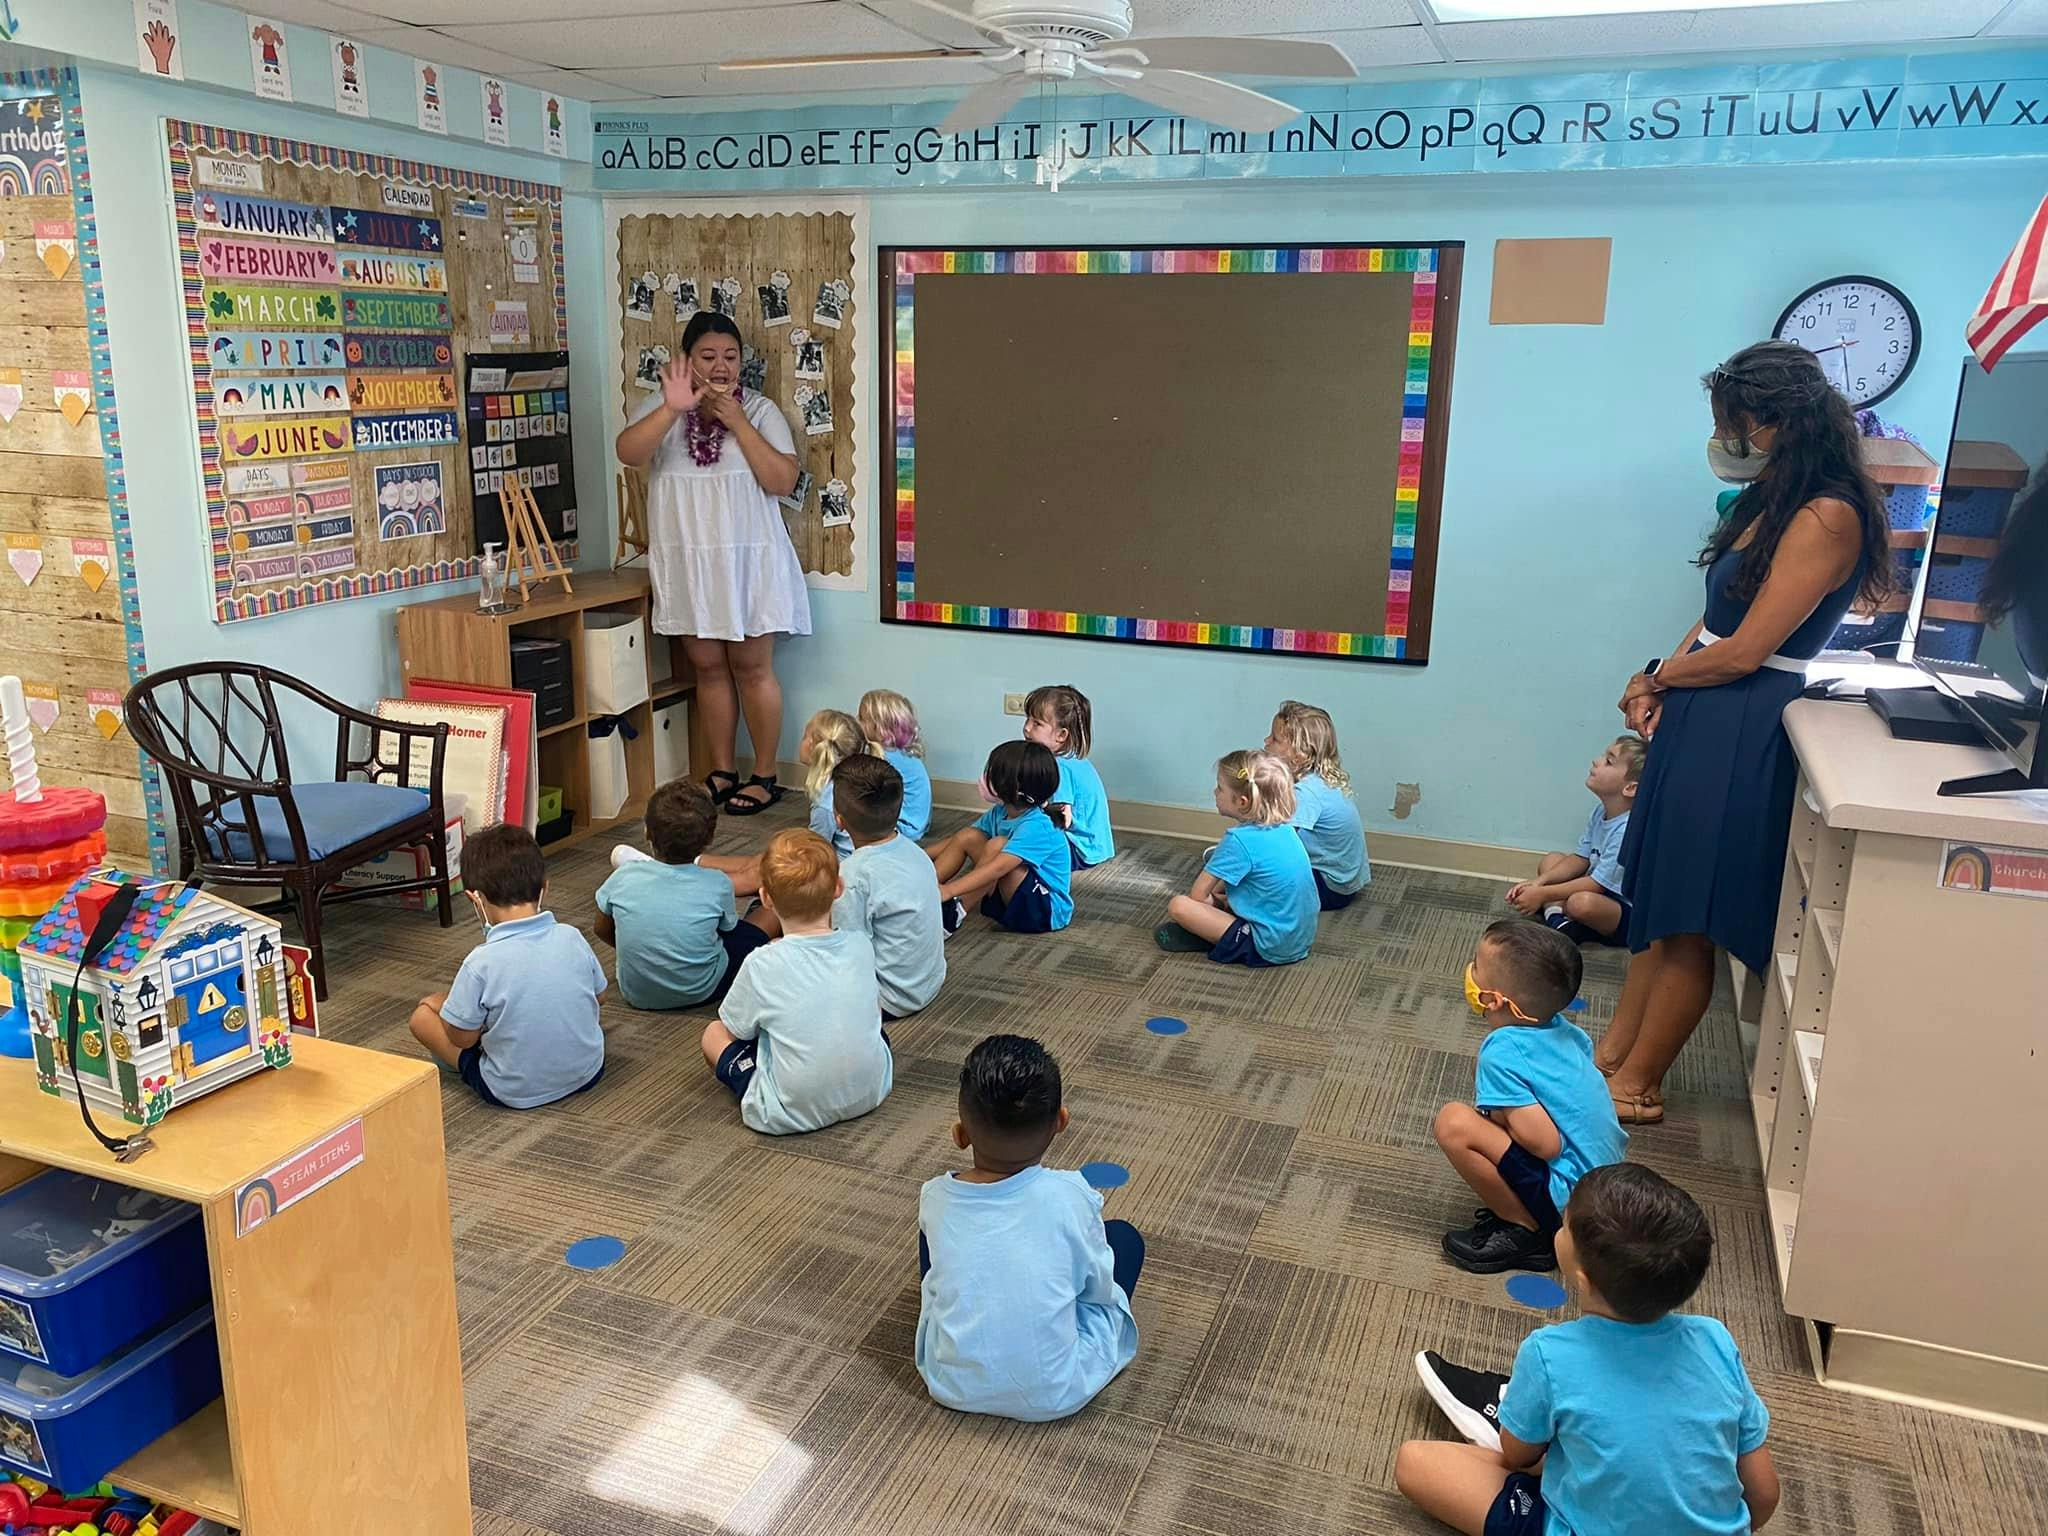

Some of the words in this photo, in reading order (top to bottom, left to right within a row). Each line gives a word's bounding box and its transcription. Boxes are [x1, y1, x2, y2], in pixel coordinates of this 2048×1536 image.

[602, 137, 640, 169] aA
[649, 137, 686, 170] bB
[696, 136, 739, 170] cC
[748, 134, 792, 168] dD
[800, 131, 840, 166] eE
[850, 130, 890, 164] fF
[895, 127, 943, 175] gG
[1014, 124, 1041, 160] iI
[1109, 119, 1154, 157] kK
[1287, 113, 1339, 152] nN
[1351, 110, 1411, 150] oO
[1420, 108, 1474, 161] pP
[1483, 104, 1545, 158] qQ
[1562, 102, 1611, 143] rR
[1628, 98, 1681, 140] sS
[1701, 94, 1750, 137] tT
[1759, 92, 1822, 135] uU
[1836, 87, 1899, 131] vV
[1907, 83, 2006, 128] wW
[2010, 99, 2048, 125] x
[212, 160, 247, 178] MONTHS
[384, 187, 431, 206] CALENDAR
[222, 201, 309, 237] JANUARY
[367, 217, 412, 244] JULY
[224, 245, 318, 279] FEBRUARY
[361, 258, 428, 288] AUGUST
[237, 294, 316, 322] MARCH
[1818, 302, 1833, 316] 11
[1843, 294, 1860, 309] 12
[1870, 303, 1877, 316] 1
[356, 299, 440, 326] SEPTEMBER
[1800, 315, 1817, 329] 10
[1883, 317, 1896, 331] 2
[244, 339, 320, 366] APRIL
[363, 341, 436, 365] OCTOBER
[1888, 340, 1899, 354] 3
[1877, 362, 1888, 376] 4
[363, 379, 442, 405] NOVEMBER
[1855, 377, 1867, 391] 5
[260, 383, 305, 410] MAY
[261, 425, 321, 455] JUNE
[371, 418, 443, 446] DECEMBER
[246, 467, 270, 481] DAYS
[254, 499, 288, 516] SUNDAY
[255, 528, 289, 544] MONDAY
[317, 551, 352, 568] SATURDAY
[258, 560, 291, 577] TUESDAY
[448, 725, 488, 739] Horner
[376, 870, 406, 881] Support
[208, 991, 214, 1006] 1
[282, 1161, 317, 1189] STEAM
[319, 1141, 351, 1169] ITEMS
